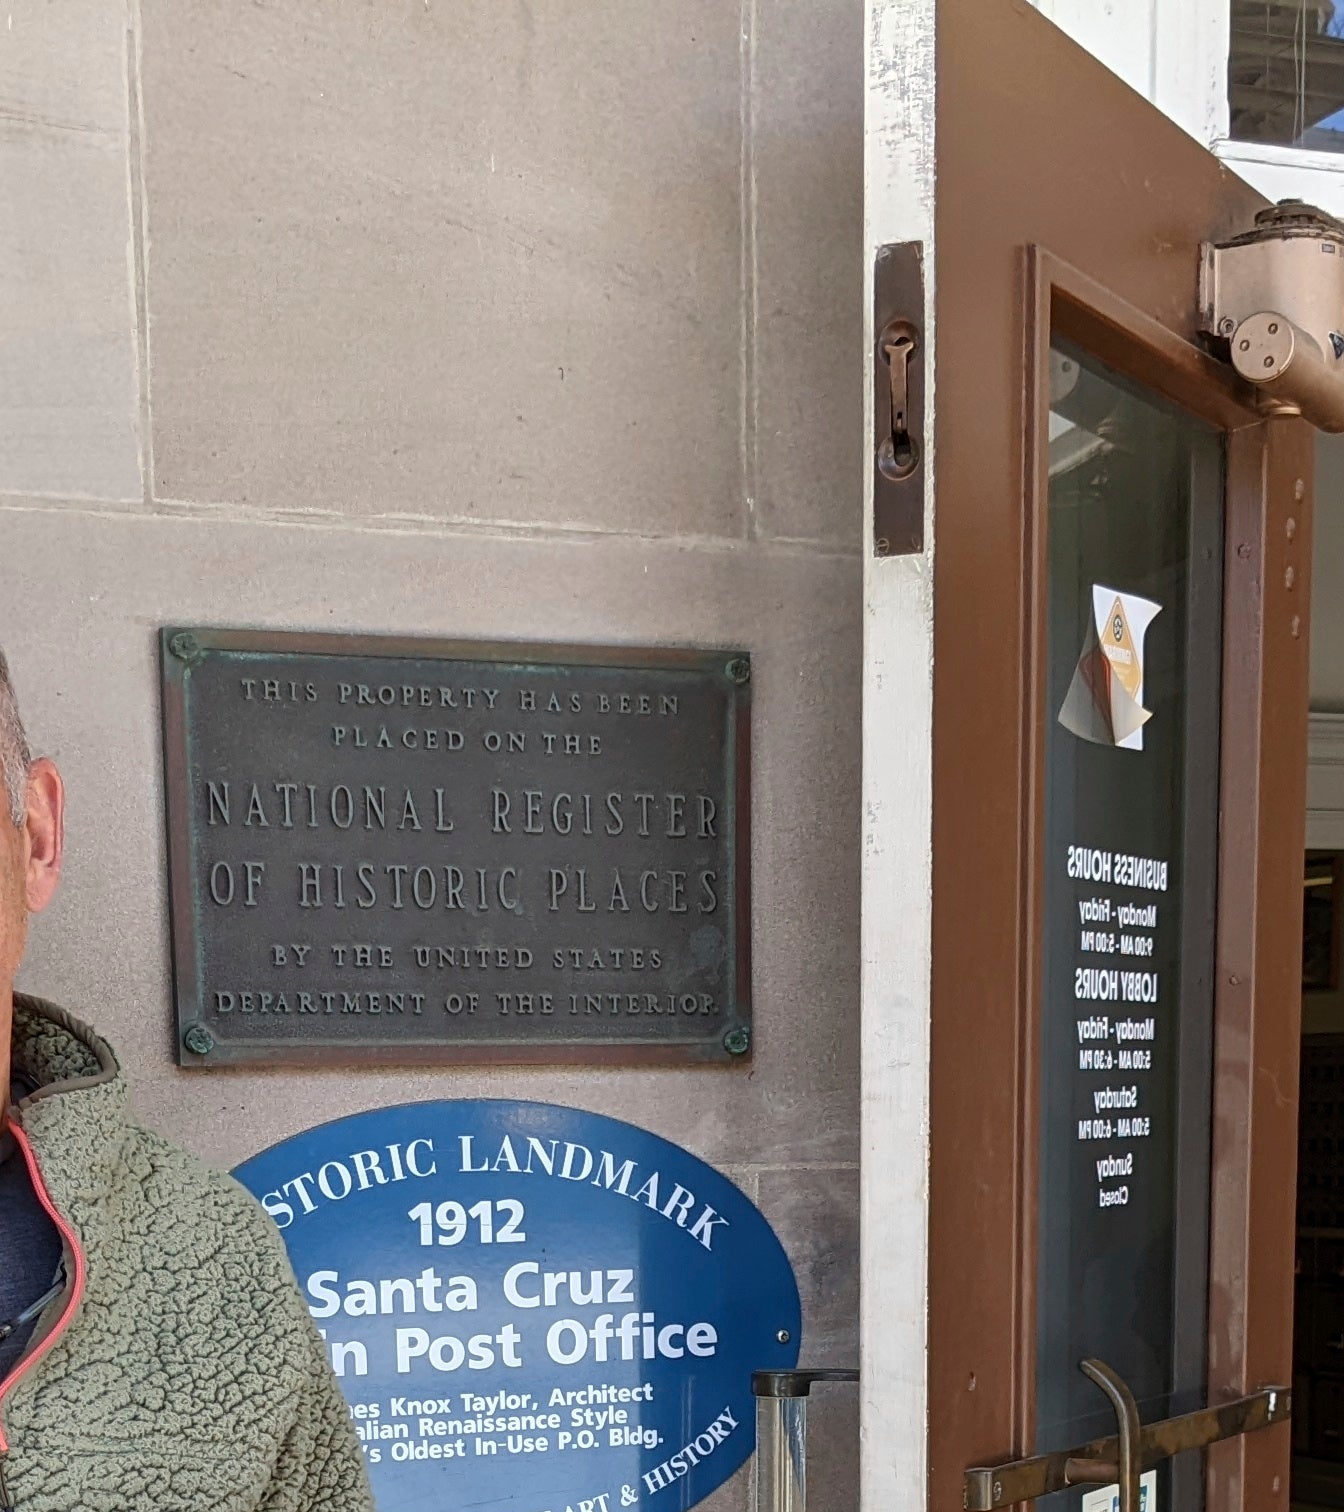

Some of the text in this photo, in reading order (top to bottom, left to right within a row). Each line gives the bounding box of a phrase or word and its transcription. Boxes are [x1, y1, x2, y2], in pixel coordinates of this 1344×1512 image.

[241, 678, 679, 716] THIS PROPERTY HAS BEEN
[332, 727, 603, 755] PLACED ON THE
[207, 782, 717, 838] NATIONAL REGISTER
[210, 862, 718, 913] OF HISTORIC PLACES
[272, 945, 662, 969] BY THE UNITED STATES
[215, 992, 426, 1014] DEPARTMENT
[446, 993, 478, 1015] OF
[496, 993, 553, 1015] THE
[457, 1134, 730, 1251] LANDMARK
[408, 1199, 526, 1246] 1912
[307, 1261, 634, 1318] Santa Cruz
[397, 1323, 522, 1374] Post
[546, 1312, 718, 1365] Office
[390, 1397, 451, 1416] Knox
[460, 1390, 539, 1416] Taylor,
[548, 1383, 654, 1407] Architect
[419, 1410, 561, 1436] Renaissance
[571, 1405, 628, 1430] Style
[391, 1438, 465, 1462] Oldest
[475, 1434, 548, 1456] In-Use
[558, 1430, 599, 1450] P.O.
[609, 1426, 664, 1449] Bldg.
[620, 1484, 639, 1507] &
[642, 1405, 739, 1495] HISTORY
